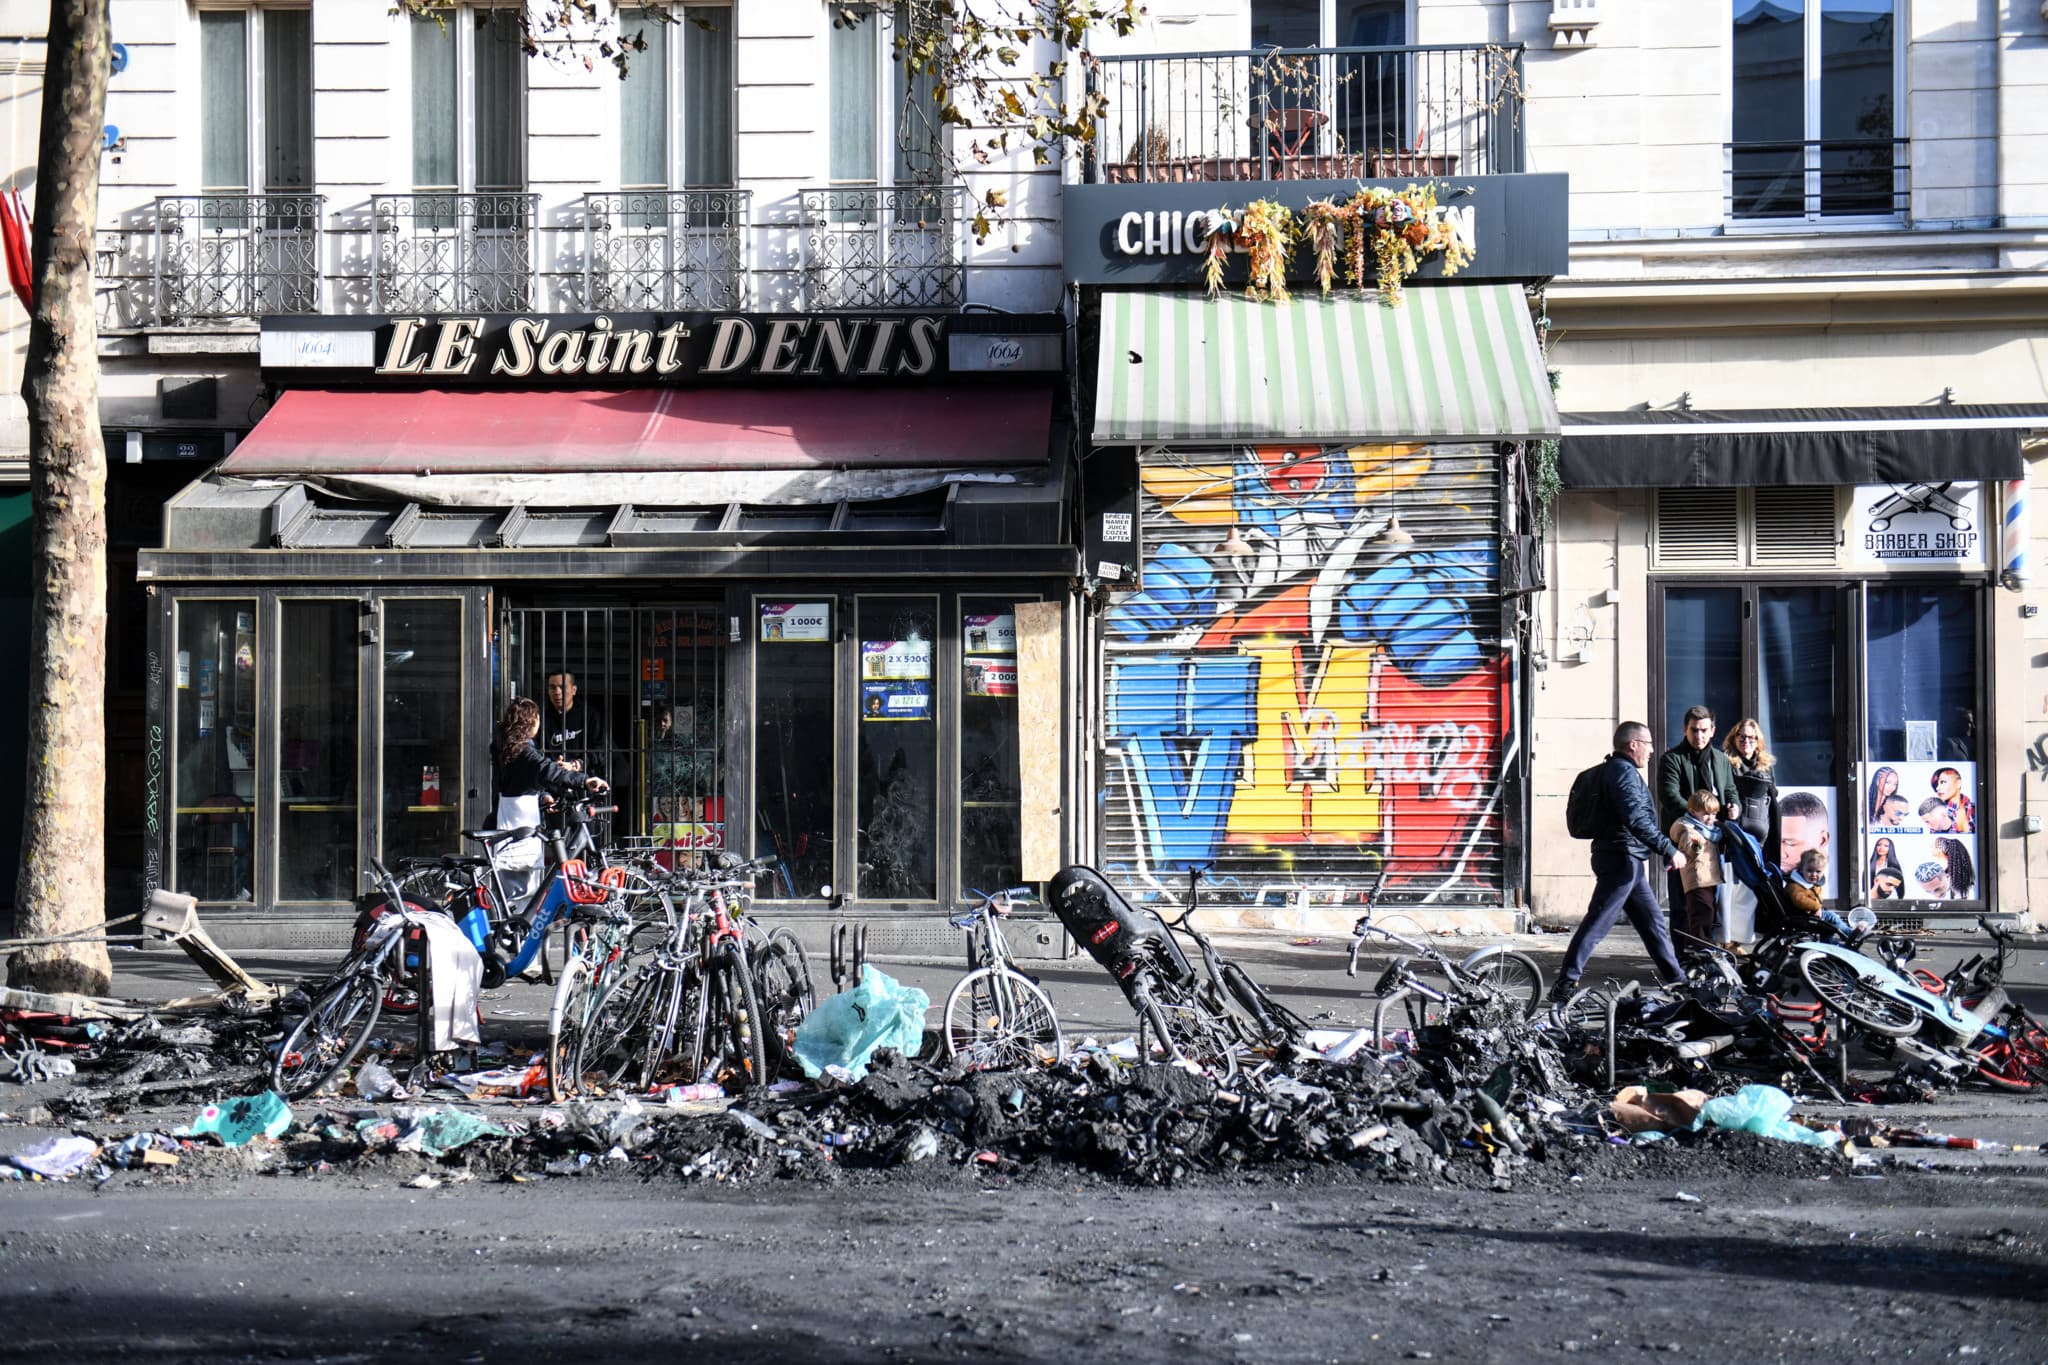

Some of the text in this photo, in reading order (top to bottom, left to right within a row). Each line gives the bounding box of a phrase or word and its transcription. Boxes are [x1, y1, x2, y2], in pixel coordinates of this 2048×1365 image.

[375, 315, 948, 376] LE Saint DENIS
[180, 445, 195, 456] 22
[1865, 532, 1978, 549] BARBER SHOP
[1880, 550, 1916, 558] HAIRCUTS
[1917, 550, 1933, 558] AND
